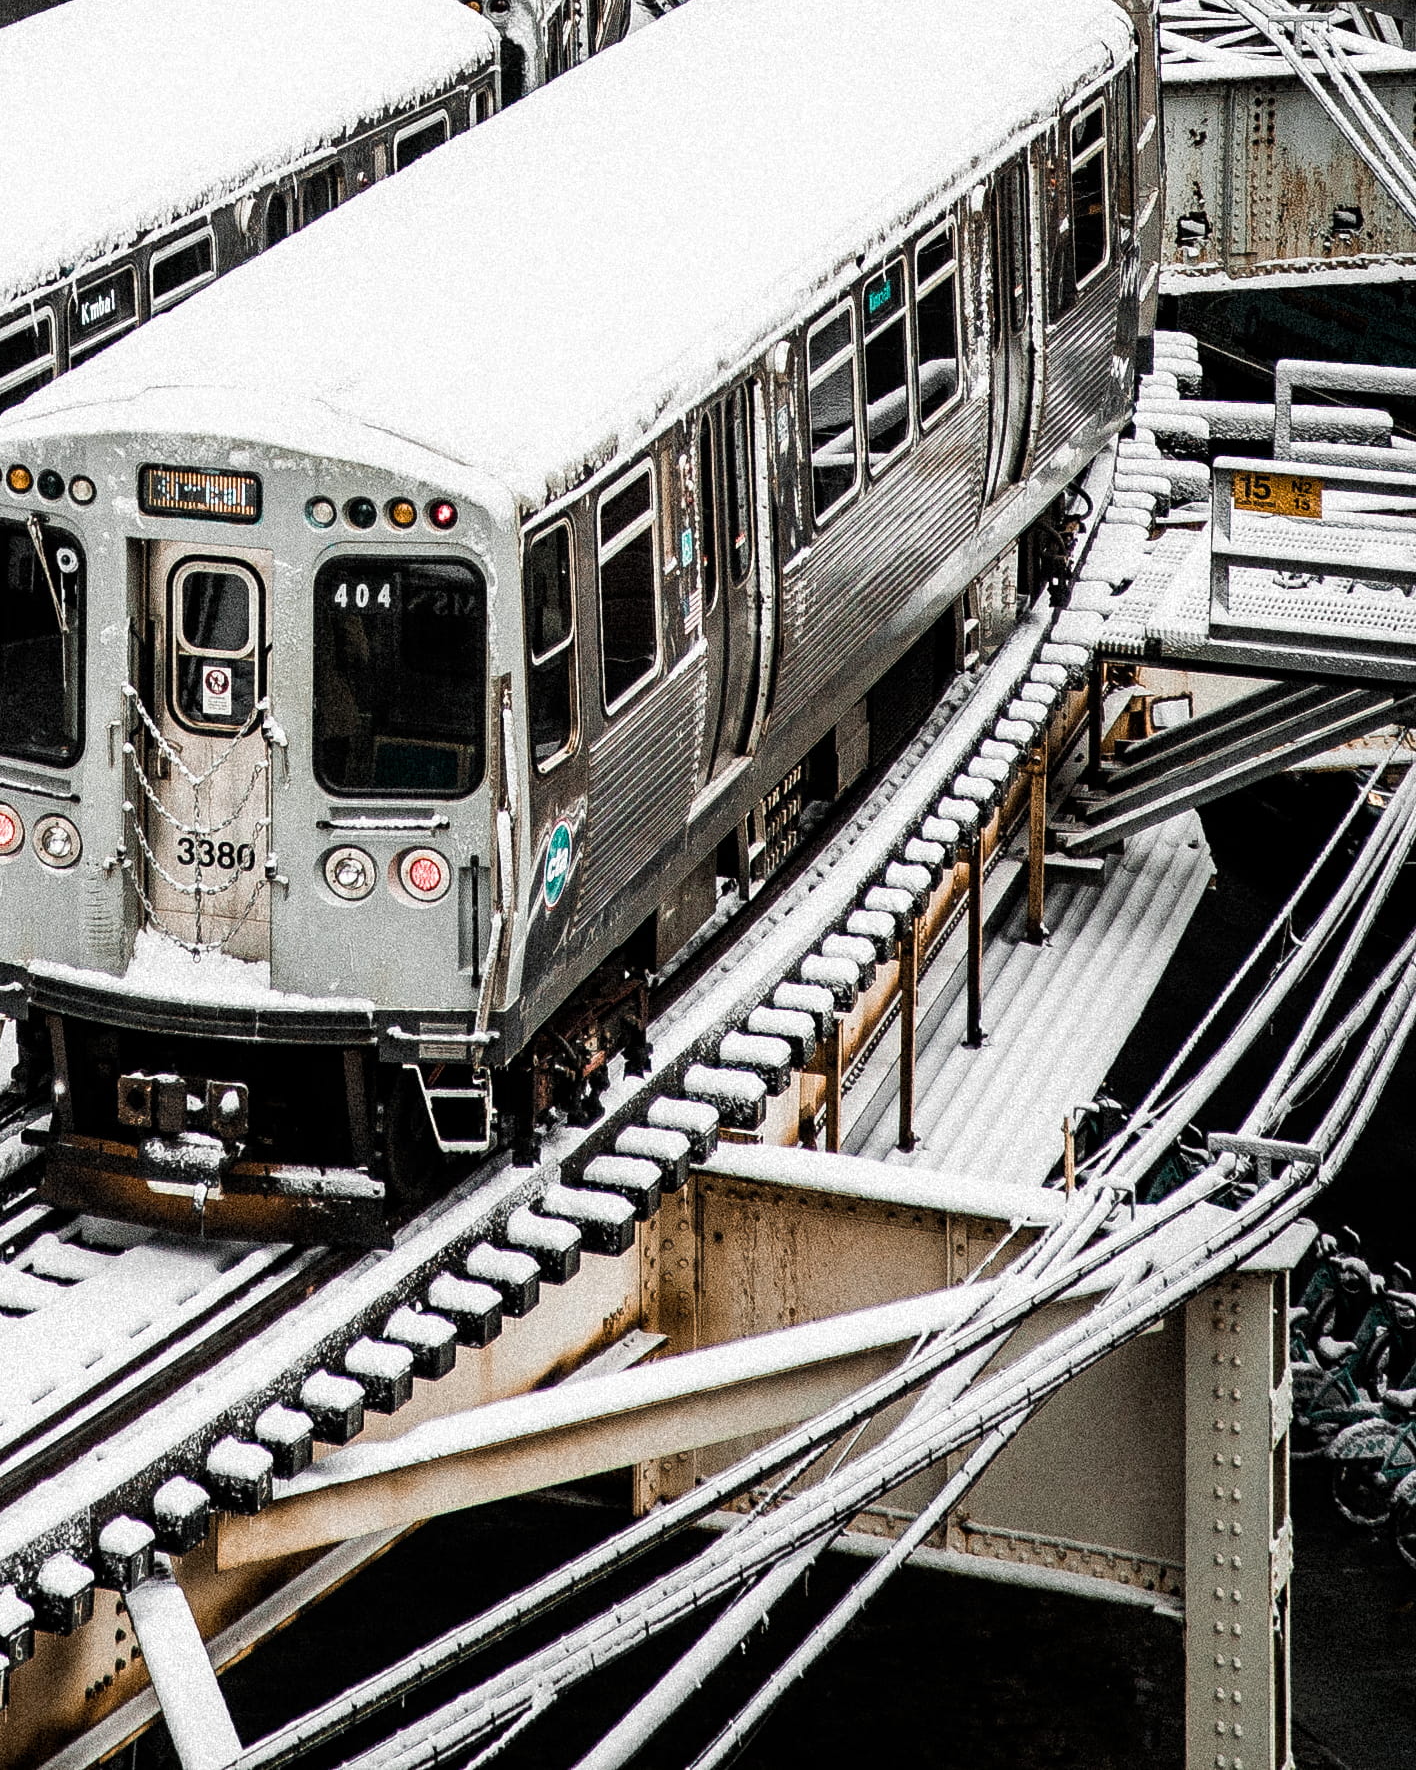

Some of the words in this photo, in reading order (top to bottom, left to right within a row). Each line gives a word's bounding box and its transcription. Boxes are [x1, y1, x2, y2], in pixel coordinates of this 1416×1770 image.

[1240, 474, 1272, 500] 15
[1291, 480, 1313, 495] N2
[1293, 497, 1311, 511] 15
[334, 583, 392, 609] 404
[176, 837, 256, 872] 3380
[546, 847, 569, 883] cta
